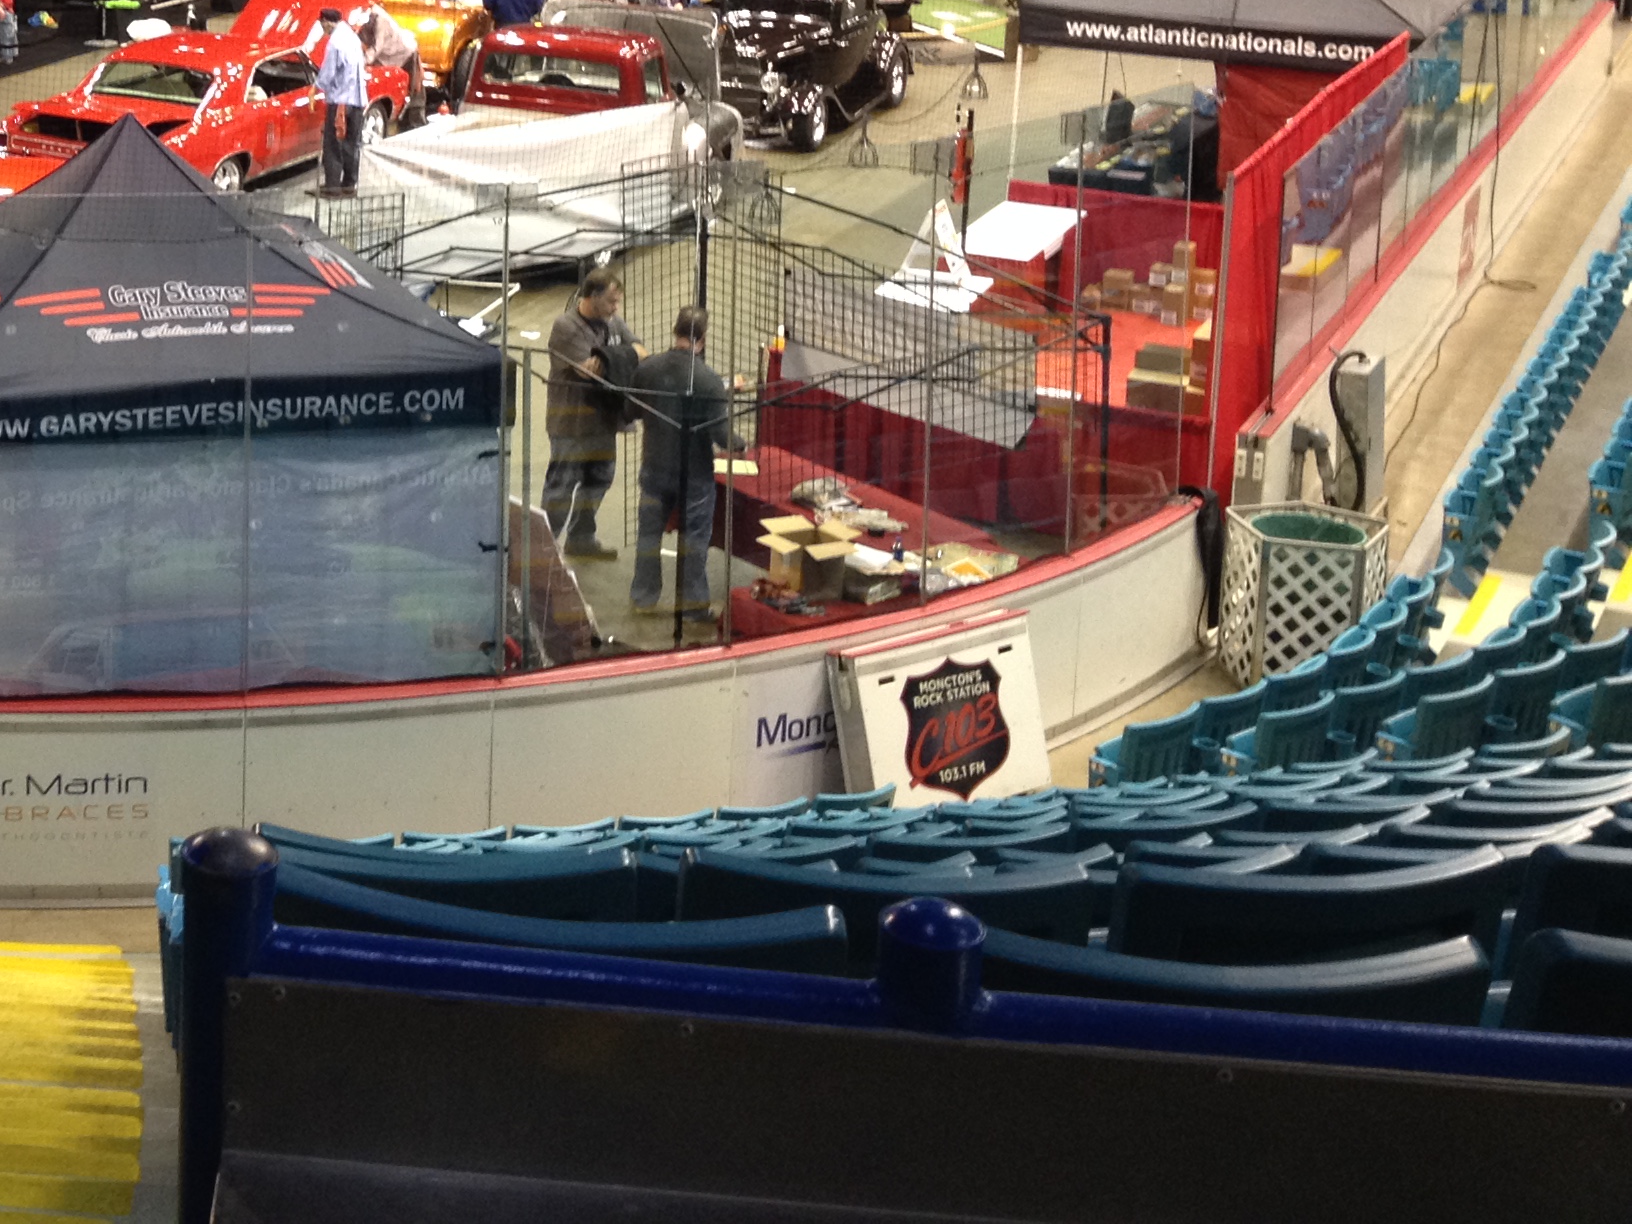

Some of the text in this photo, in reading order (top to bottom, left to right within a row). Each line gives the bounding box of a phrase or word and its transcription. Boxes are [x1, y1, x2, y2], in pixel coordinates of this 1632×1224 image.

[1066, 19, 1375, 61] www.atlanticnationals.com
[108, 281, 247, 307] Gary Steeves
[140, 304, 230, 321] Insurance
[919, 669, 982, 694] MONCTON'S
[913, 680, 990, 710] ROCK STATION
[911, 692, 998, 779] C103
[26, 772, 148, 796] Martin
[938, 760, 986, 783] 103.1 FM
[4, 804, 149, 822] BRACES
